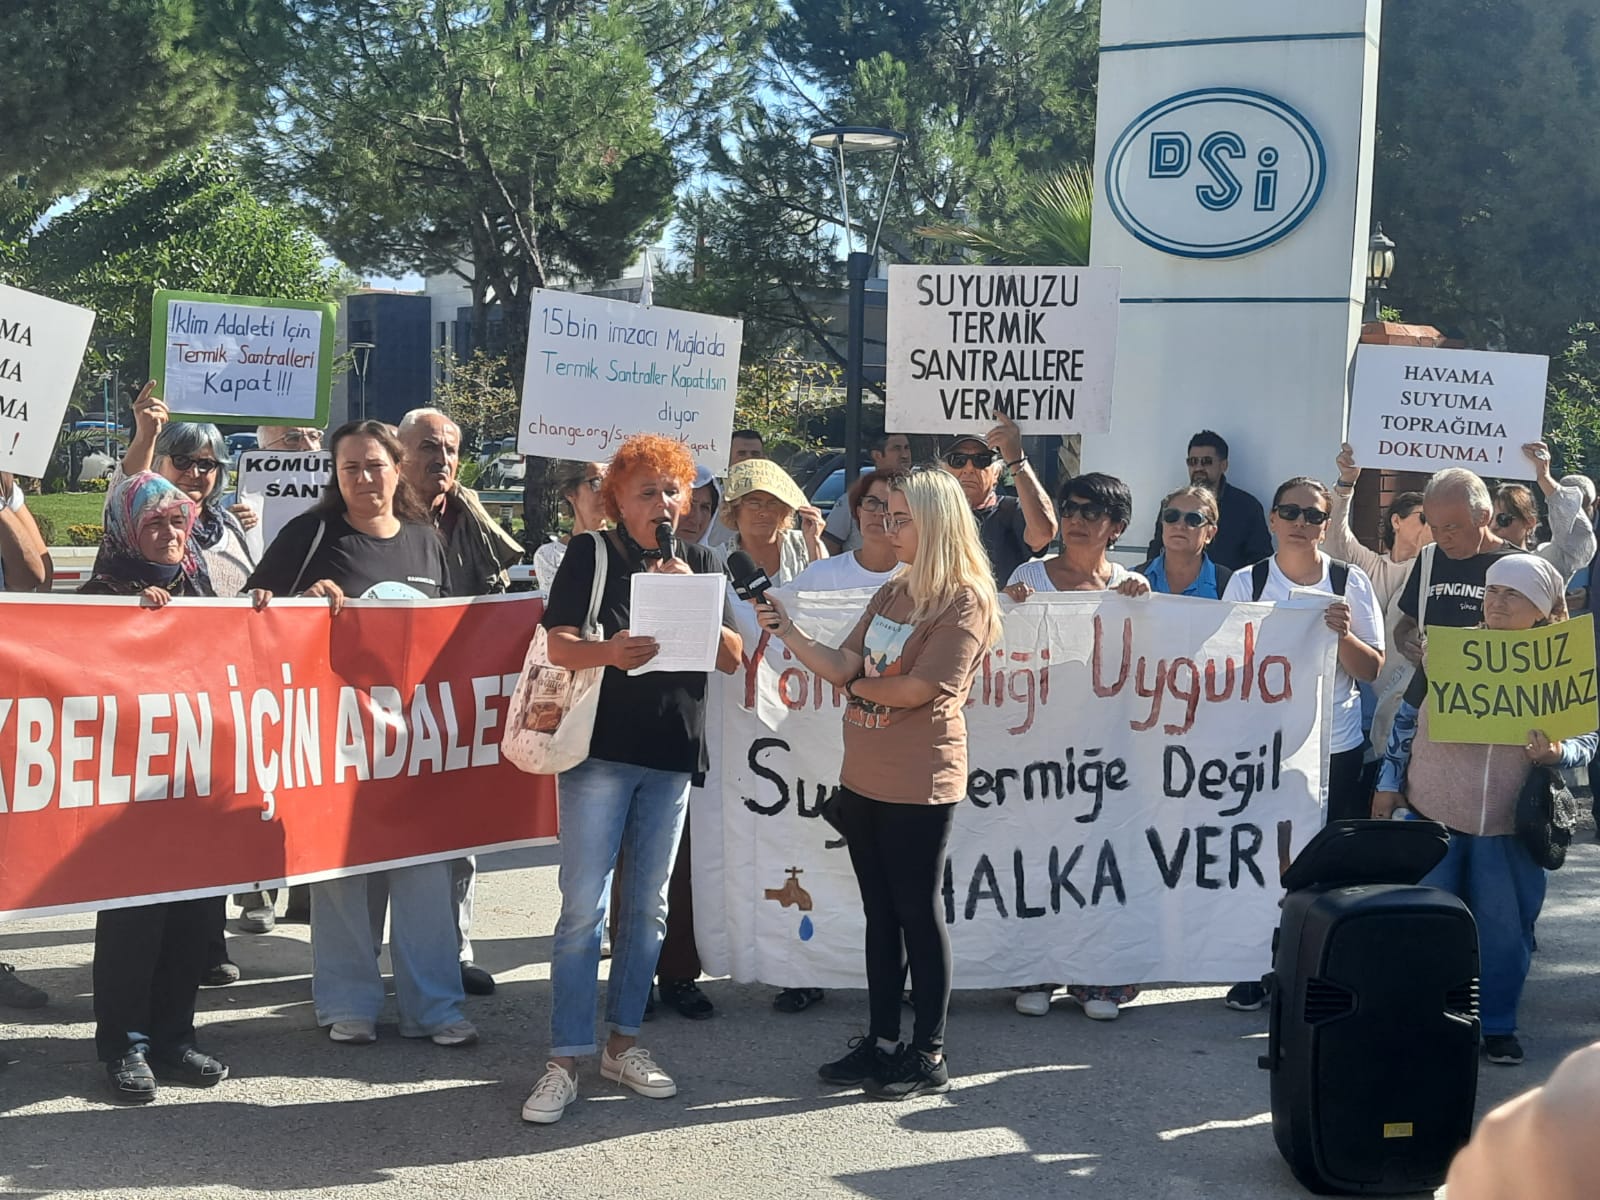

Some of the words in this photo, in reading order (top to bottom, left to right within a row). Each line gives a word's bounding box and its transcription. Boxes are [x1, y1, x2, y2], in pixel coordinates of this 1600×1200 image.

[916, 274, 1079, 308] SUYUMUZU
[214, 312, 275, 337] Adaleti
[608, 320, 658, 347] imzacı
[948, 308, 1046, 344] TERMİK
[237, 344, 315, 369] Santralleri
[910, 348, 1085, 382] SANTRALLERE
[605, 359, 668, 385] Santraller
[1404, 365, 1495, 386] HAVAMA
[658, 400, 699, 429] diyor
[939, 385, 1075, 421] VERMEYİN
[1400, 390, 1493, 411] SUYUMA
[1381, 415, 1508, 438] TOPRAĞIMA
[1378, 440, 1489, 462] DOKUNMA
[265, 483, 326, 498] SAN
[1462, 632, 1572, 674] SUSUZ
[1092, 614, 1293, 736] Uygula
[1431, 668, 1597, 720] YAŞANMAZ
[226, 663, 323, 821] İÇİN
[1163, 729, 1282, 817] Değil
